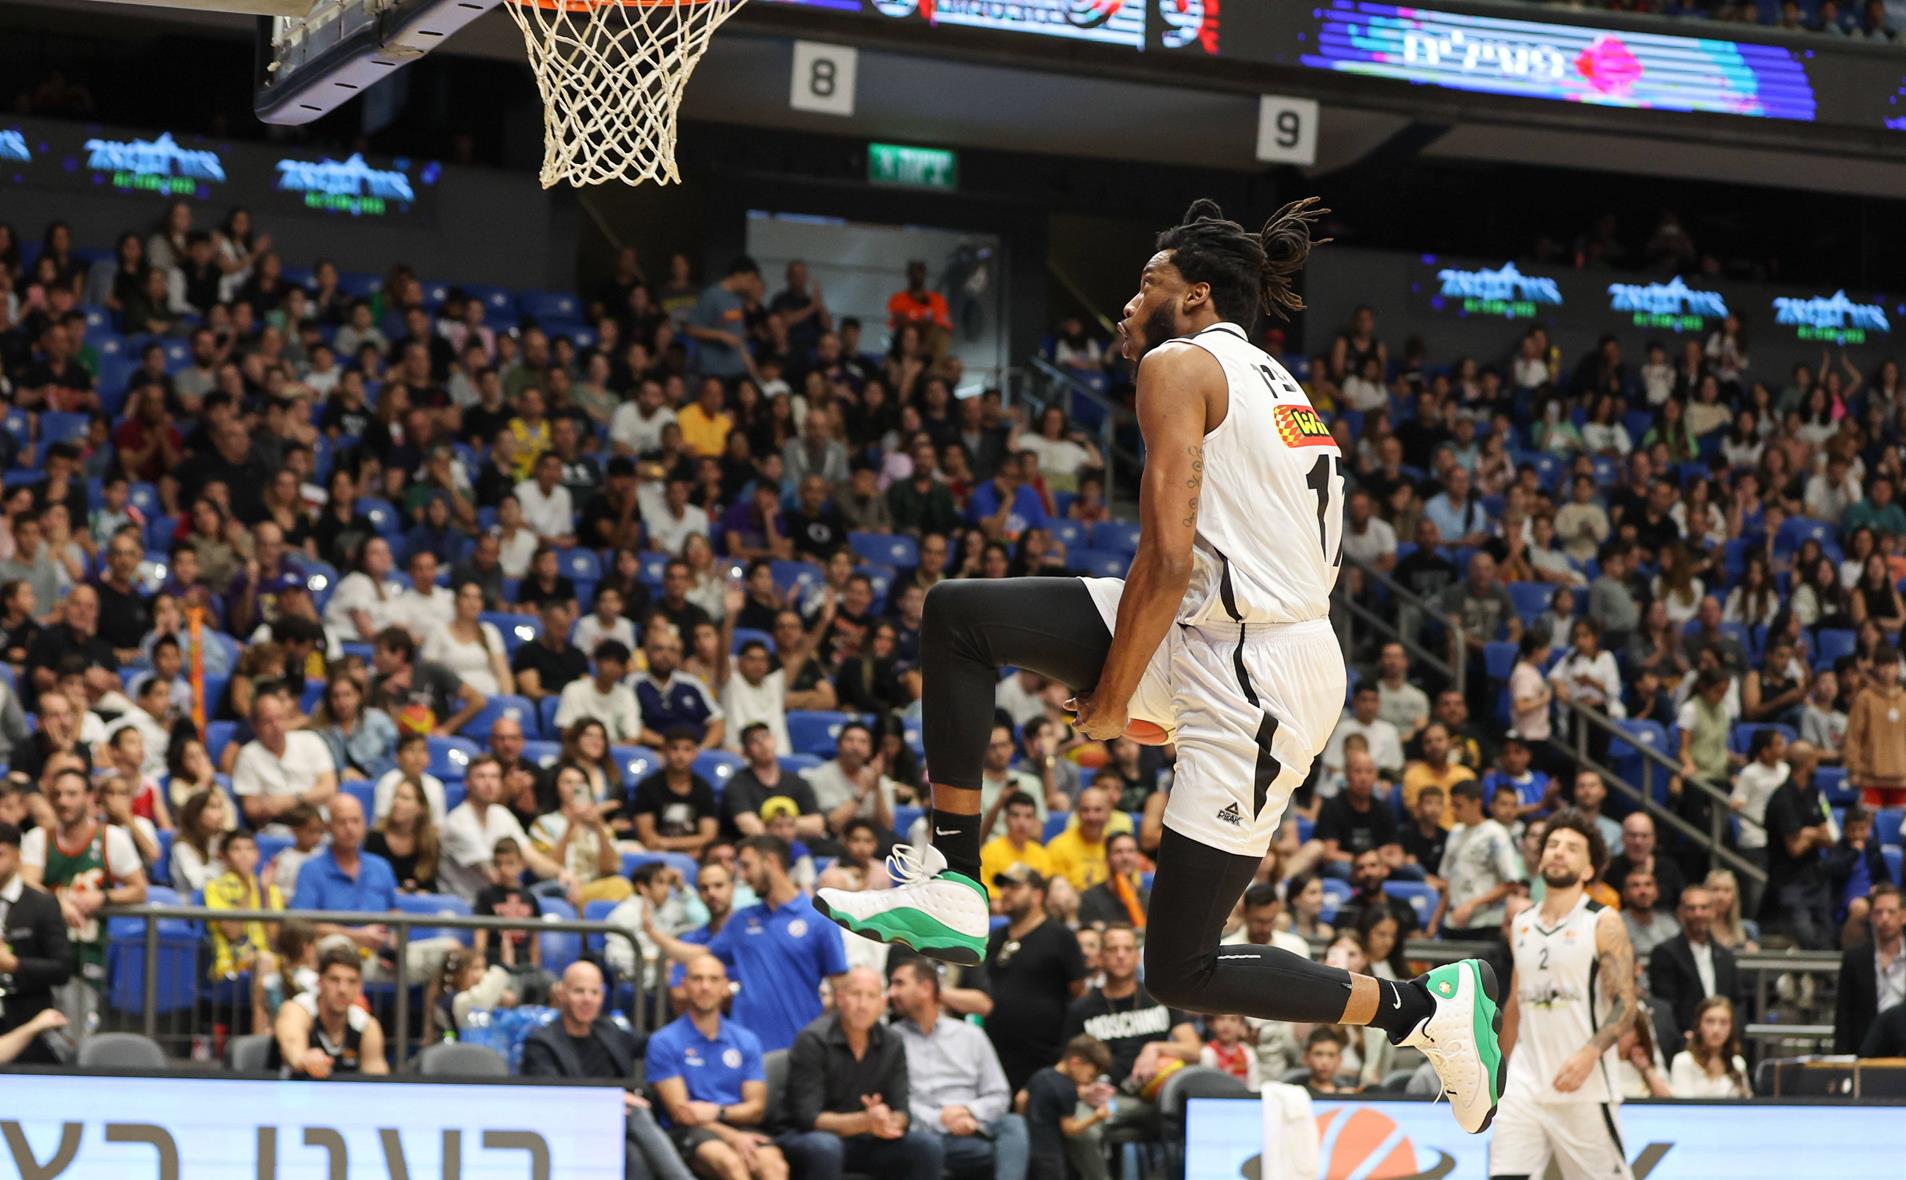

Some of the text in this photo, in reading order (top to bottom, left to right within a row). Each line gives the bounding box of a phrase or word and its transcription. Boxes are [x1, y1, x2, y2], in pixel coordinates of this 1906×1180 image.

[811, 59, 836, 97] 8
[1275, 110, 1300, 148] 9
[1539, 947, 1549, 970] 2
[1083, 1004, 1170, 1041] MOSCHINO
